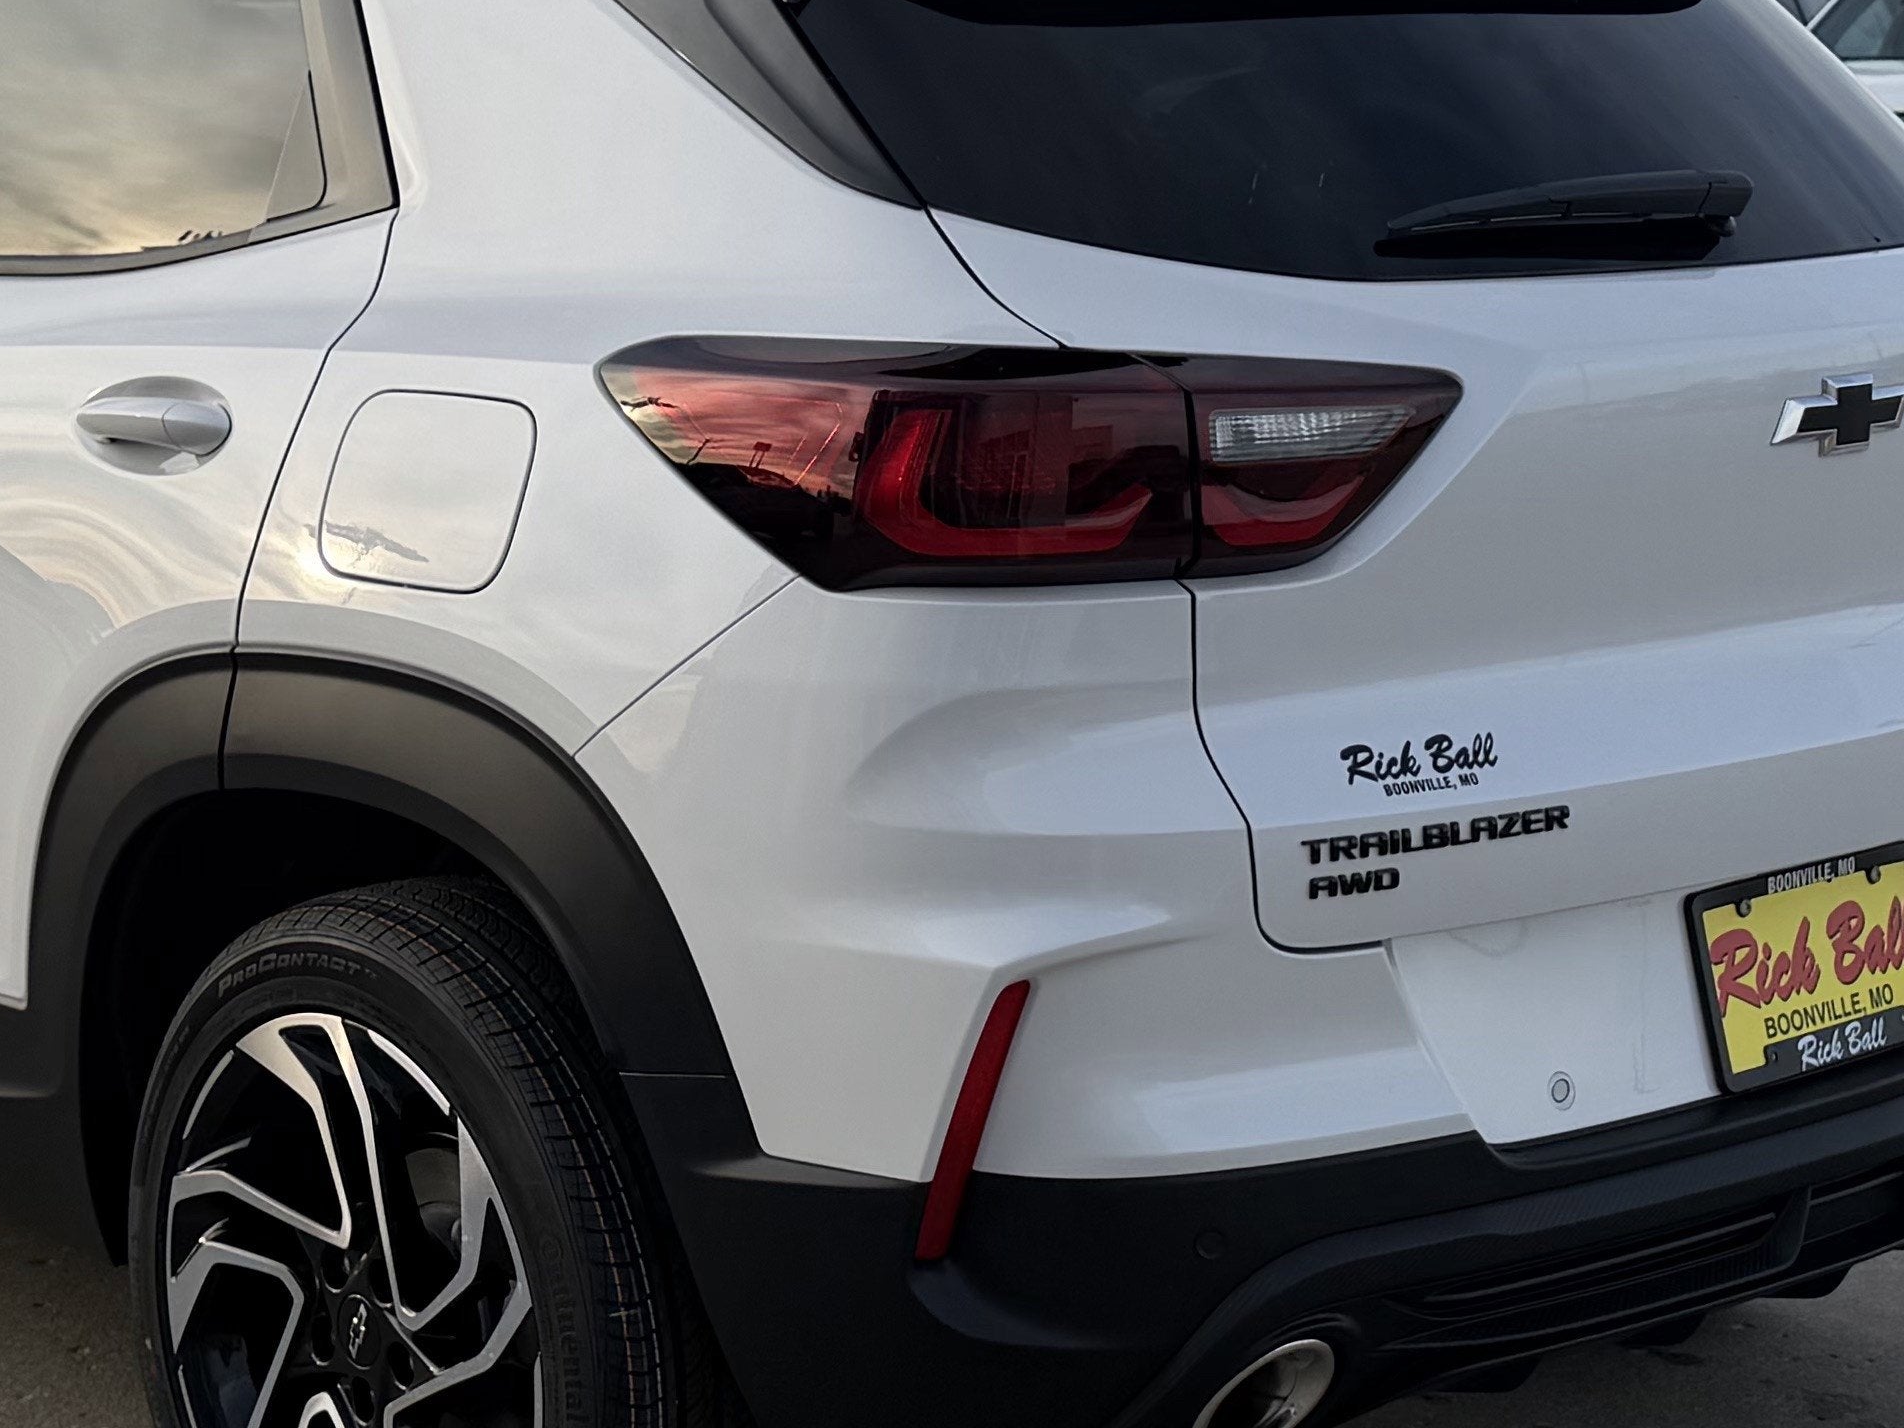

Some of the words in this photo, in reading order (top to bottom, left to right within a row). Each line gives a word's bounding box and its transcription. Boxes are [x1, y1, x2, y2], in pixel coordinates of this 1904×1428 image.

[1340, 740, 1422, 785] Rick
[1424, 732, 1498, 773] Ball
[1383, 776, 1458, 797] BOONVILLE,
[1458, 772, 1479, 787] MO
[1300, 805, 1570, 864] TRAILBLAZER
[1309, 867, 1400, 899] AWD
[1767, 861, 1836, 894] BOONVILLE,
[1837, 856, 1856, 876] MO
[1710, 916, 1821, 1018] Rick
[1764, 991, 1867, 1039] BOONVILLE,
[1869, 983, 1894, 1008] MO
[1798, 1032, 1844, 1071] Rick
[1845, 1017, 1887, 1056] Ball
